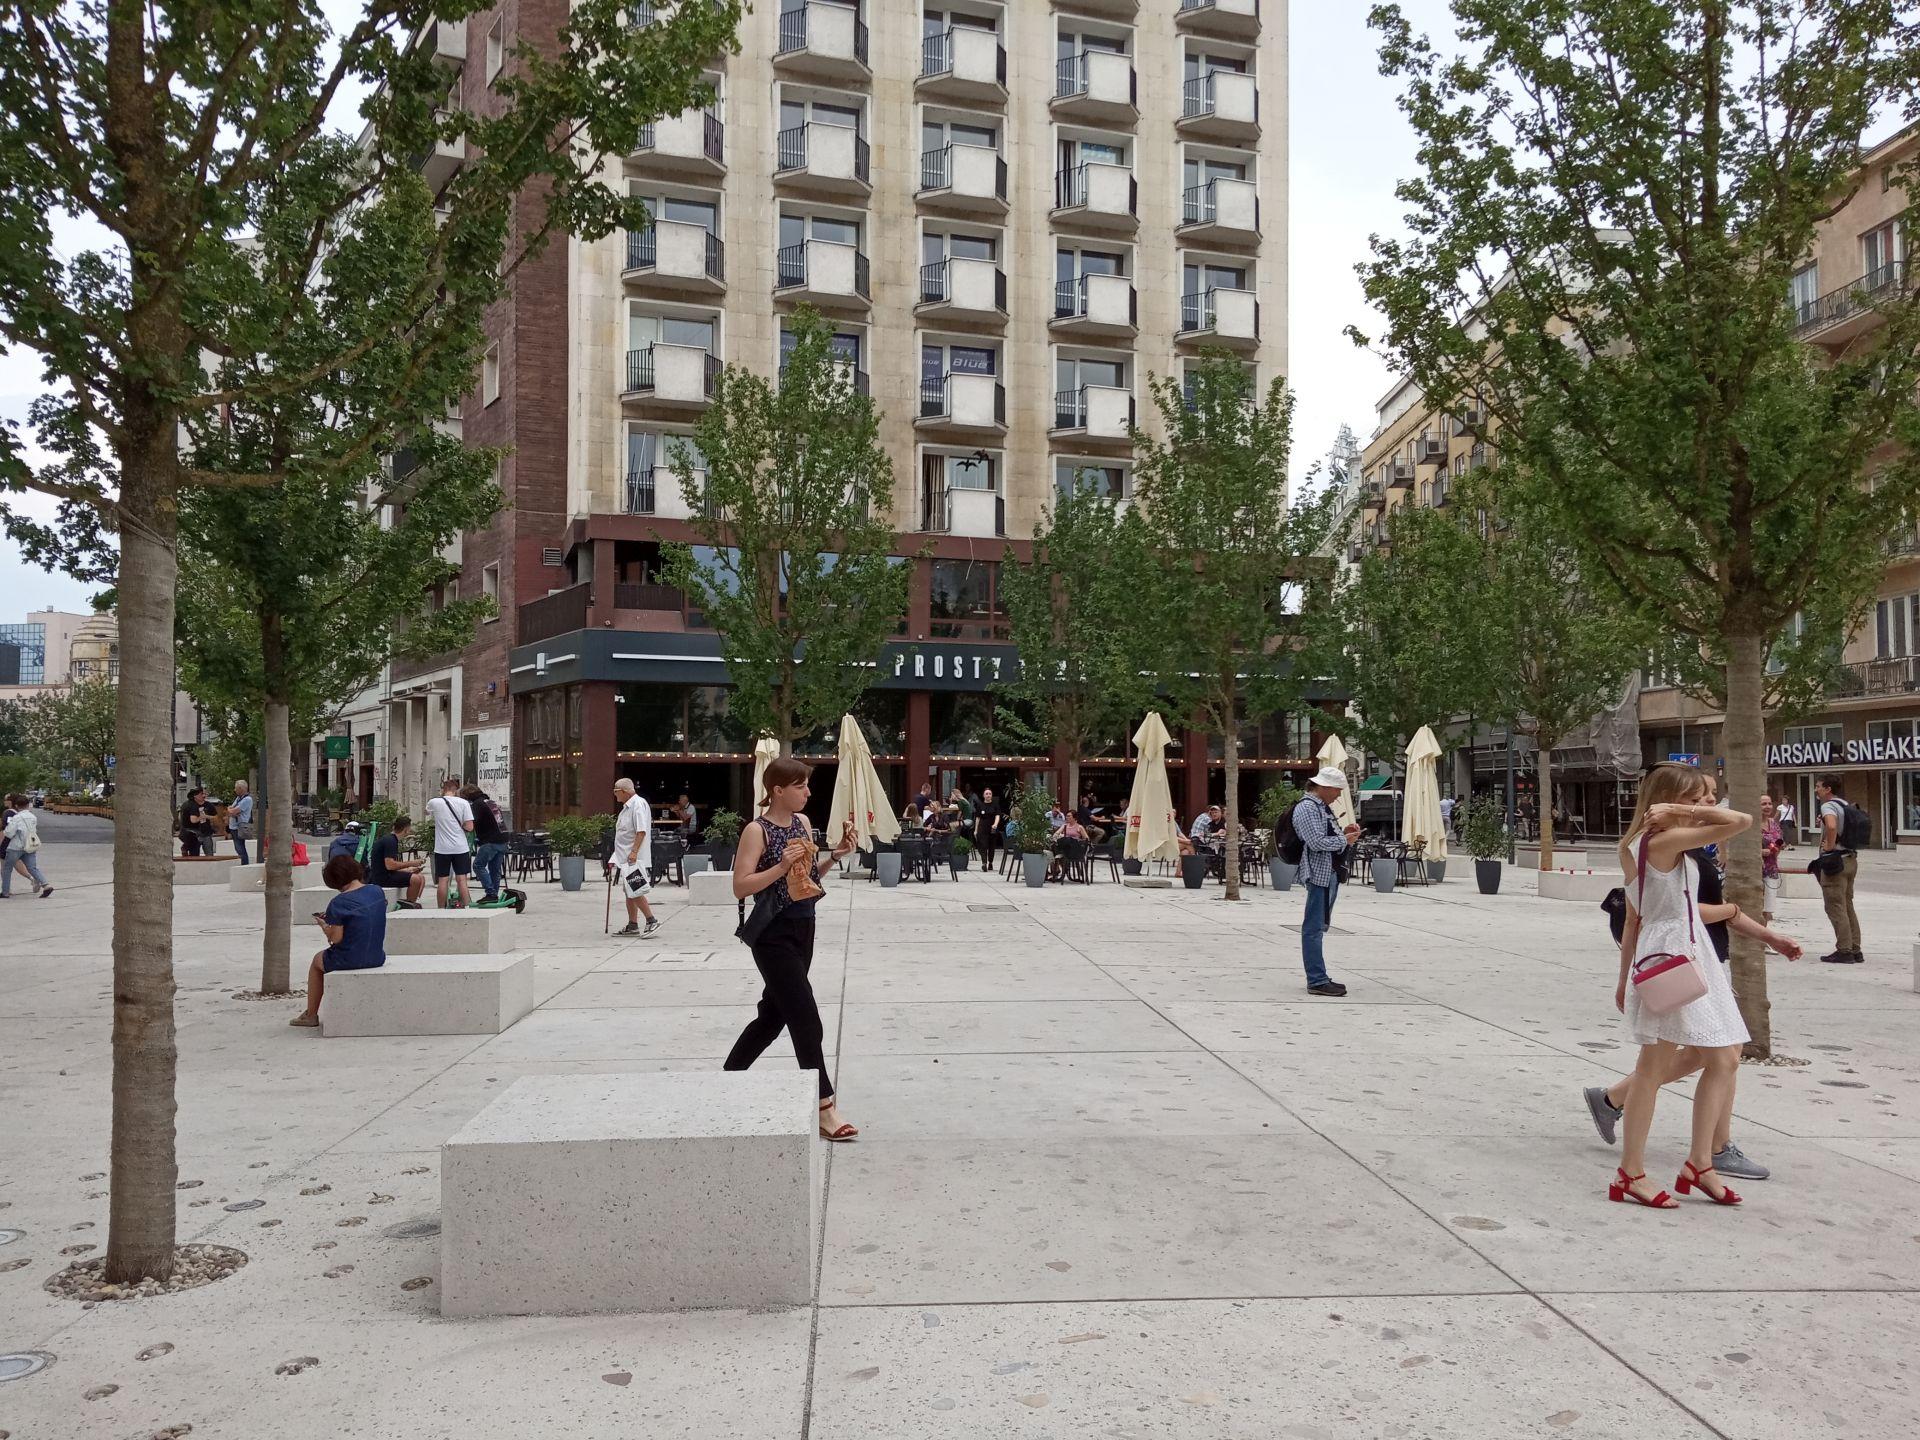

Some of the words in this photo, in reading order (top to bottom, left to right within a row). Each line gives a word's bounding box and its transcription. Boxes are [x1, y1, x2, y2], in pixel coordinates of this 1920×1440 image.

[895, 654, 1002, 680] PROSTY
[479, 749, 488, 763] Gra
[1847, 736, 1920, 762] SNEAKE
